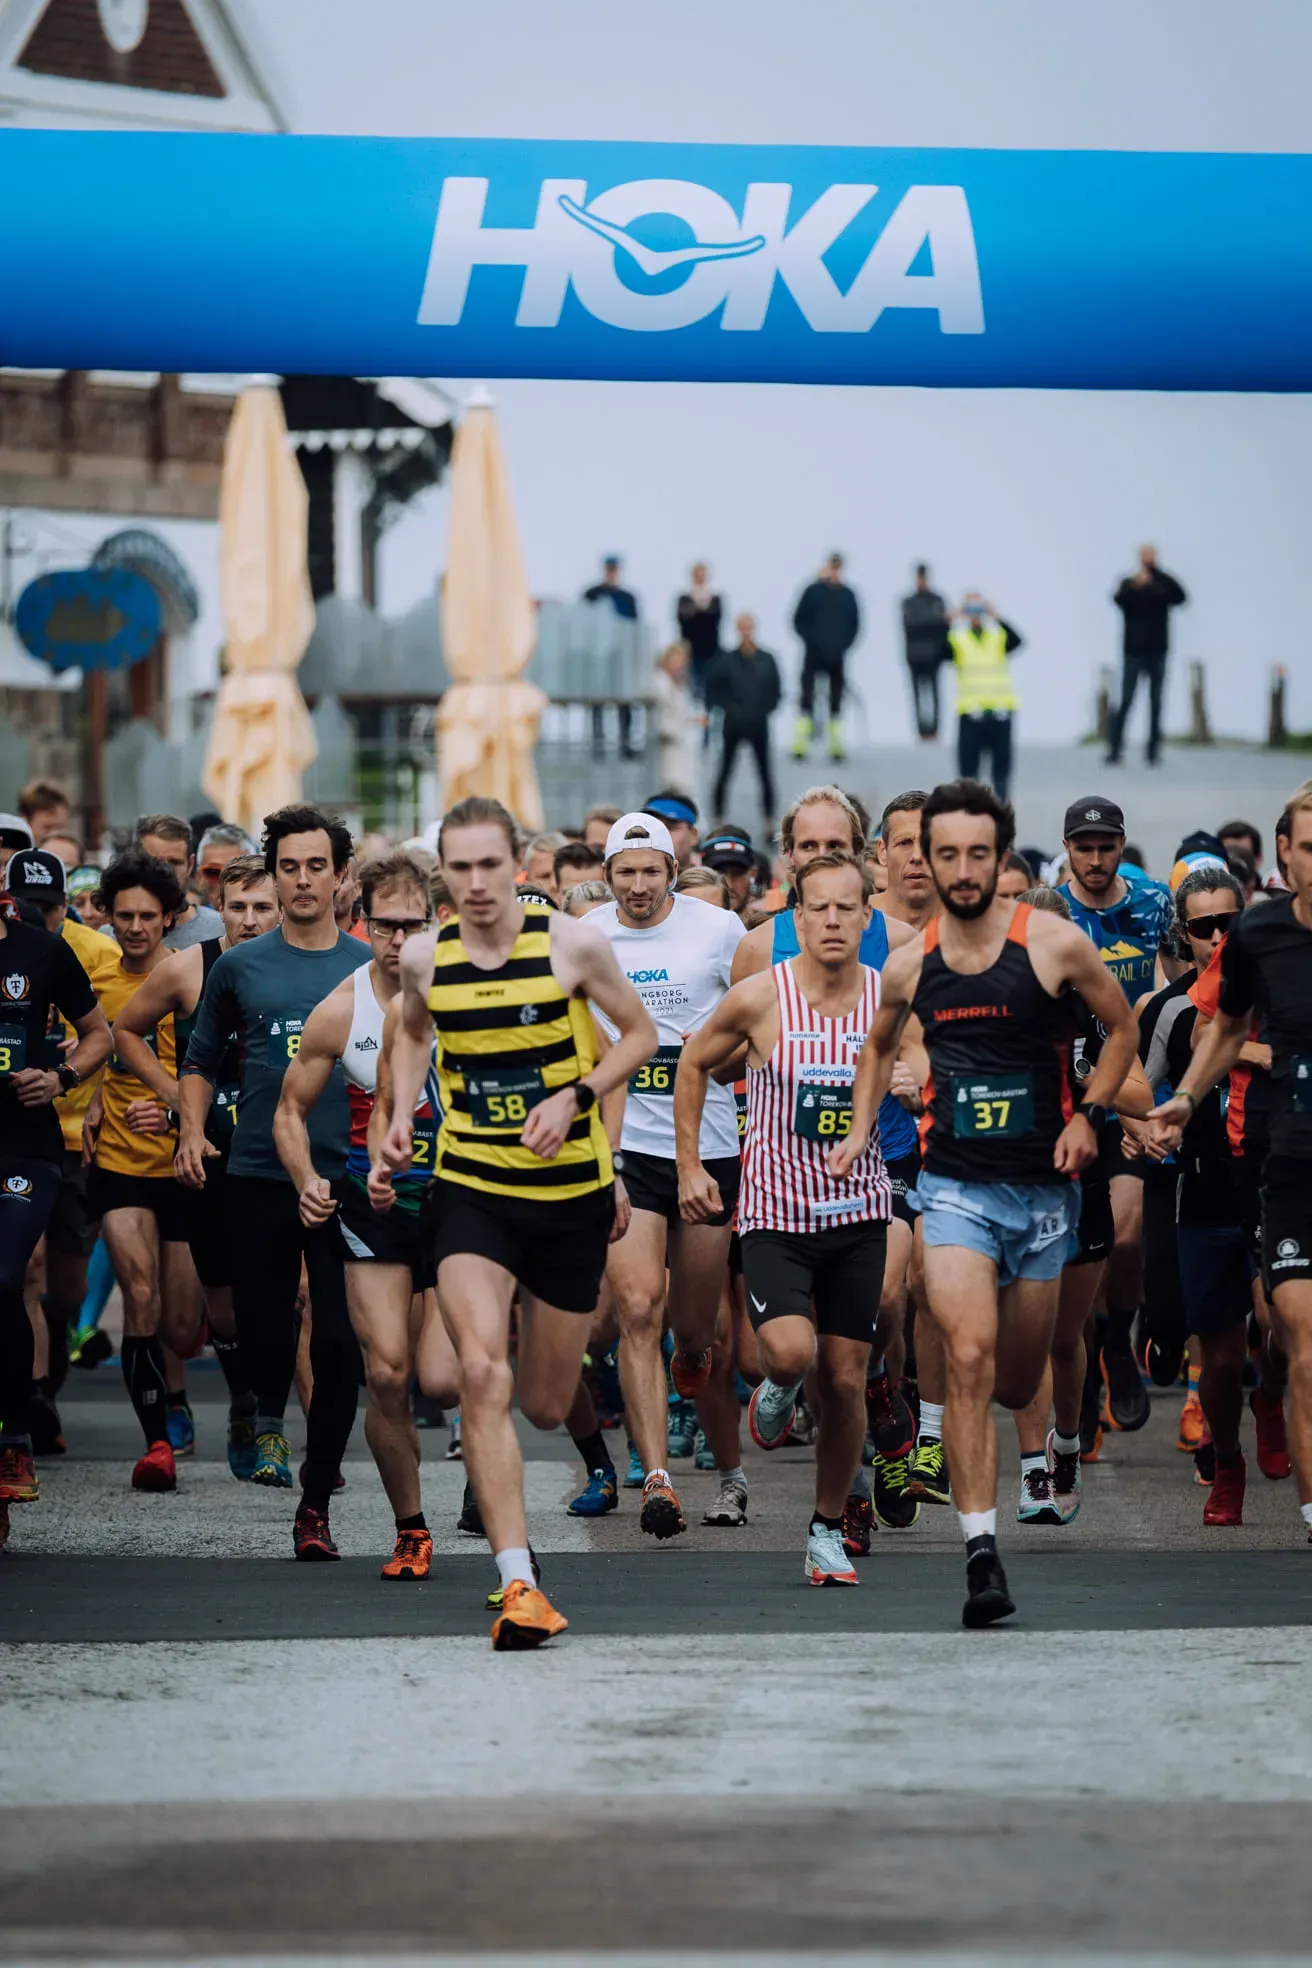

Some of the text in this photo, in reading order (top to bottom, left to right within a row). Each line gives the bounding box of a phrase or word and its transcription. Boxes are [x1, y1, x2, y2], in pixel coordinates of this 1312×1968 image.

[416, 176, 986, 335] HOKA
[933, 1005, 1014, 1021] MERRELL
[635, 1066, 669, 1089] 36
[487, 1094, 527, 1122] 58
[973, 1100, 1011, 1129] 37
[818, 1110, 853, 1135] 85
